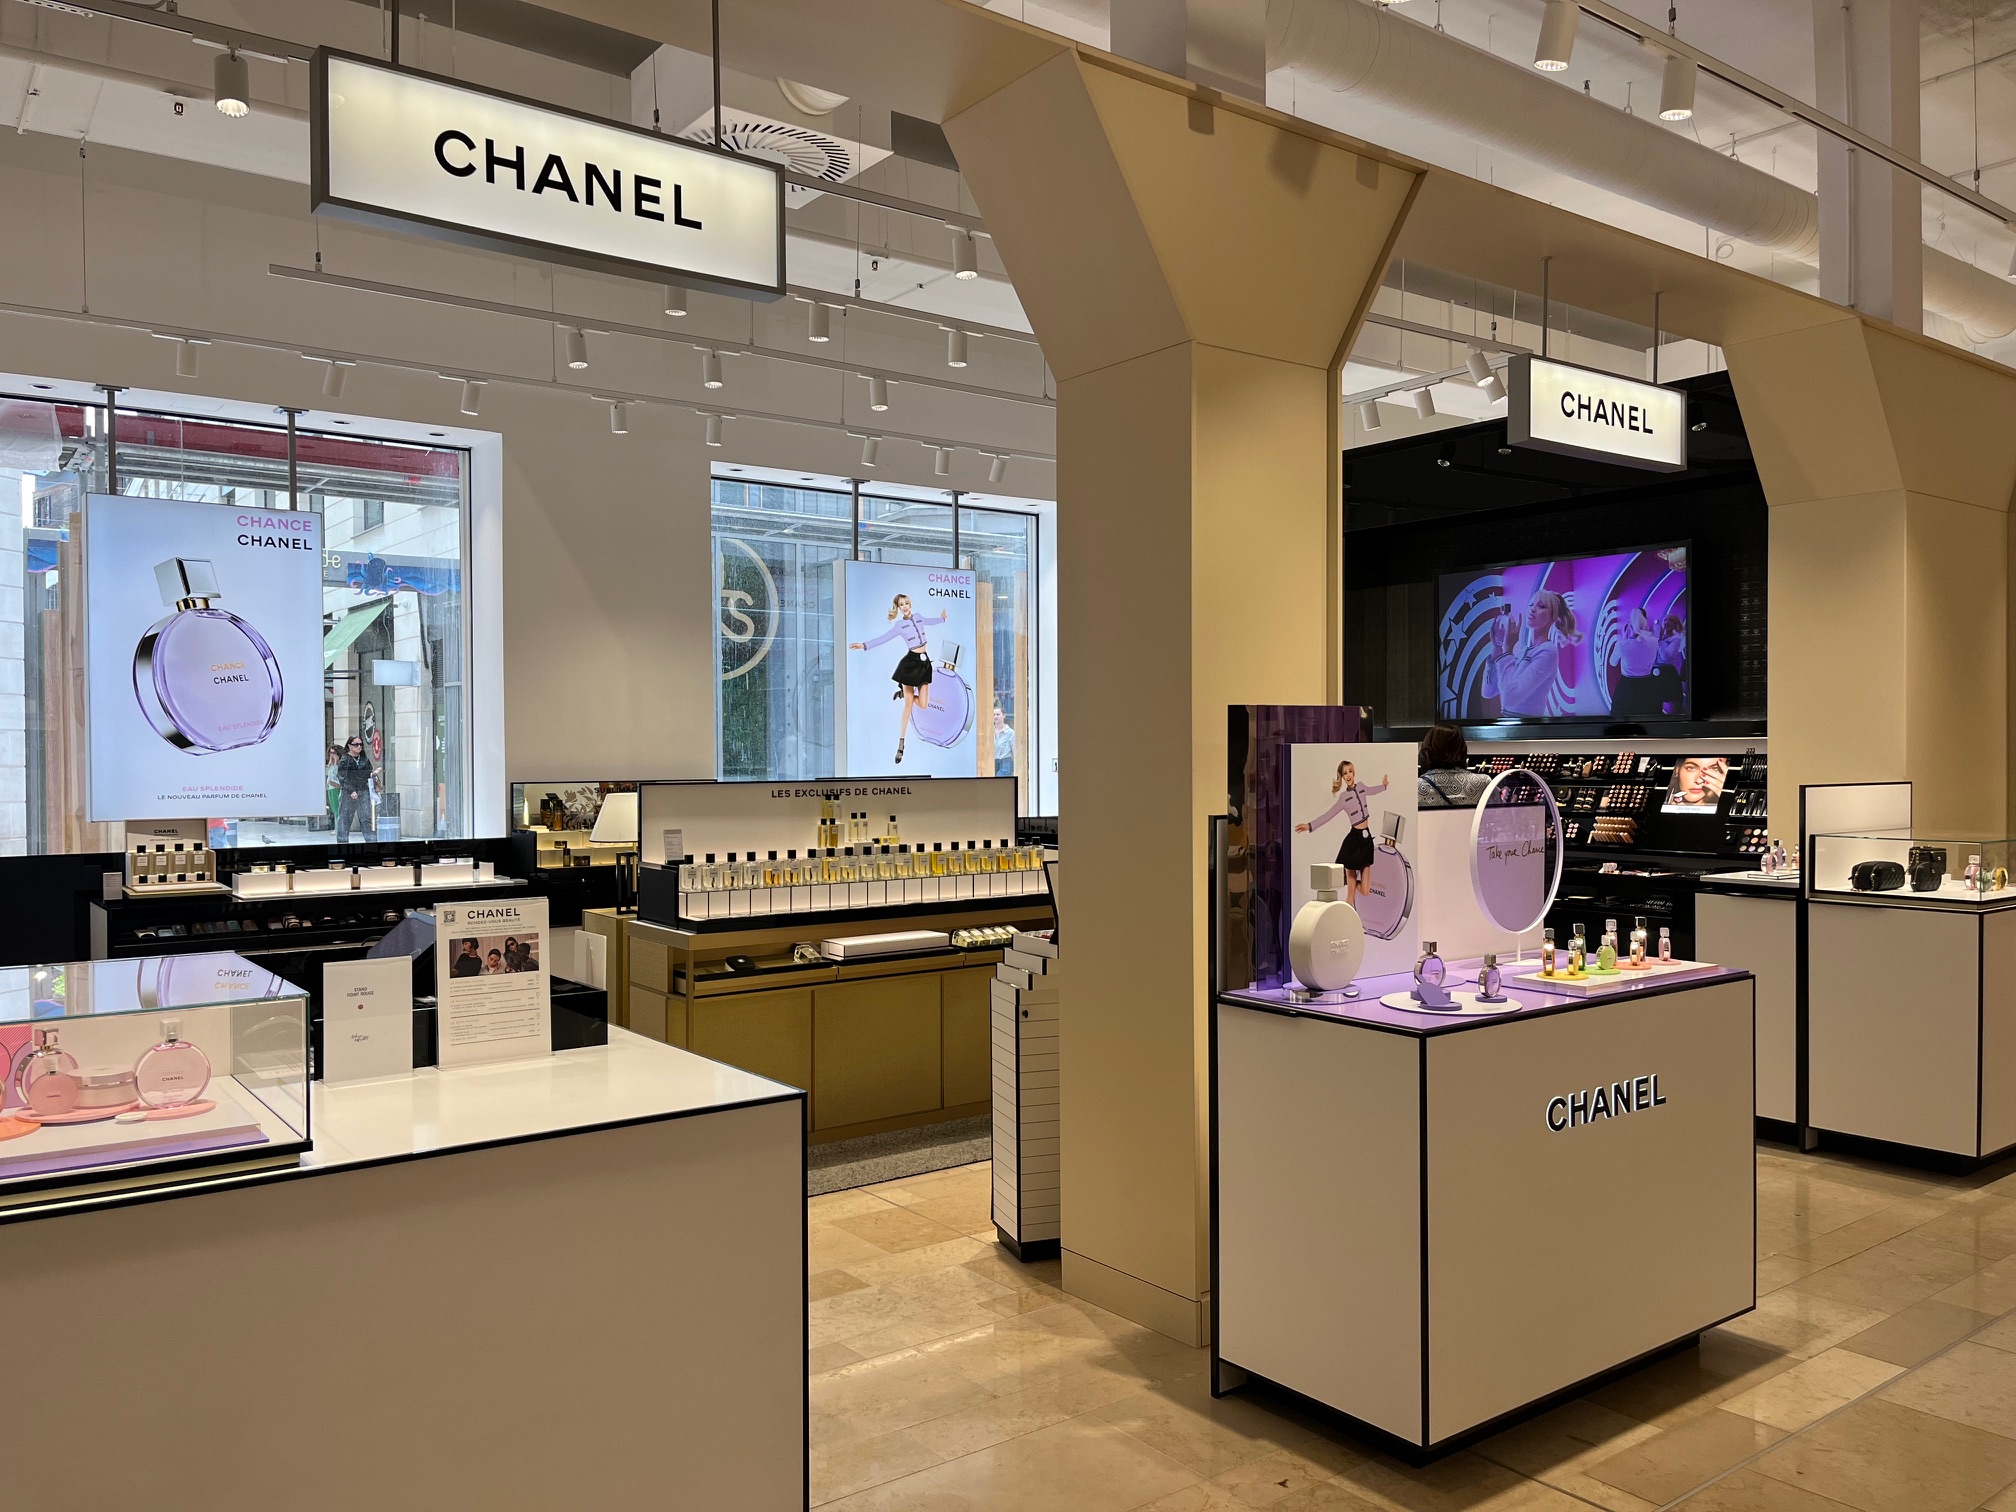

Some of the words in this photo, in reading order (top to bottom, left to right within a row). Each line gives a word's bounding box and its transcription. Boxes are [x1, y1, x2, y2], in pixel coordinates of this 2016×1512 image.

[434, 130, 702, 230] CHANEL
[1561, 391, 1653, 434] CHANEL
[236, 515, 312, 532] CHANCE
[237, 534, 313, 551] CHANEL
[928, 573, 971, 585] CHANCE
[928, 587, 971, 599] CHANEL
[210, 661, 246, 672] CHANCE
[213, 674, 249, 685] CHANEL
[927, 702, 945, 712] CHANEL
[232, 719, 265, 730] SPLENDIDE
[771, 789, 791, 798] LES
[794, 788, 851, 798] EXCLUSIFS
[854, 787, 868, 796] DE
[871, 786, 912, 796] CHANEL
[1485, 845, 1502, 860] Take
[1369, 888, 1387, 897] CHANEL
[467, 908, 521, 919] CHANEL
[1545, 1074, 1666, 1132] CHANEL
